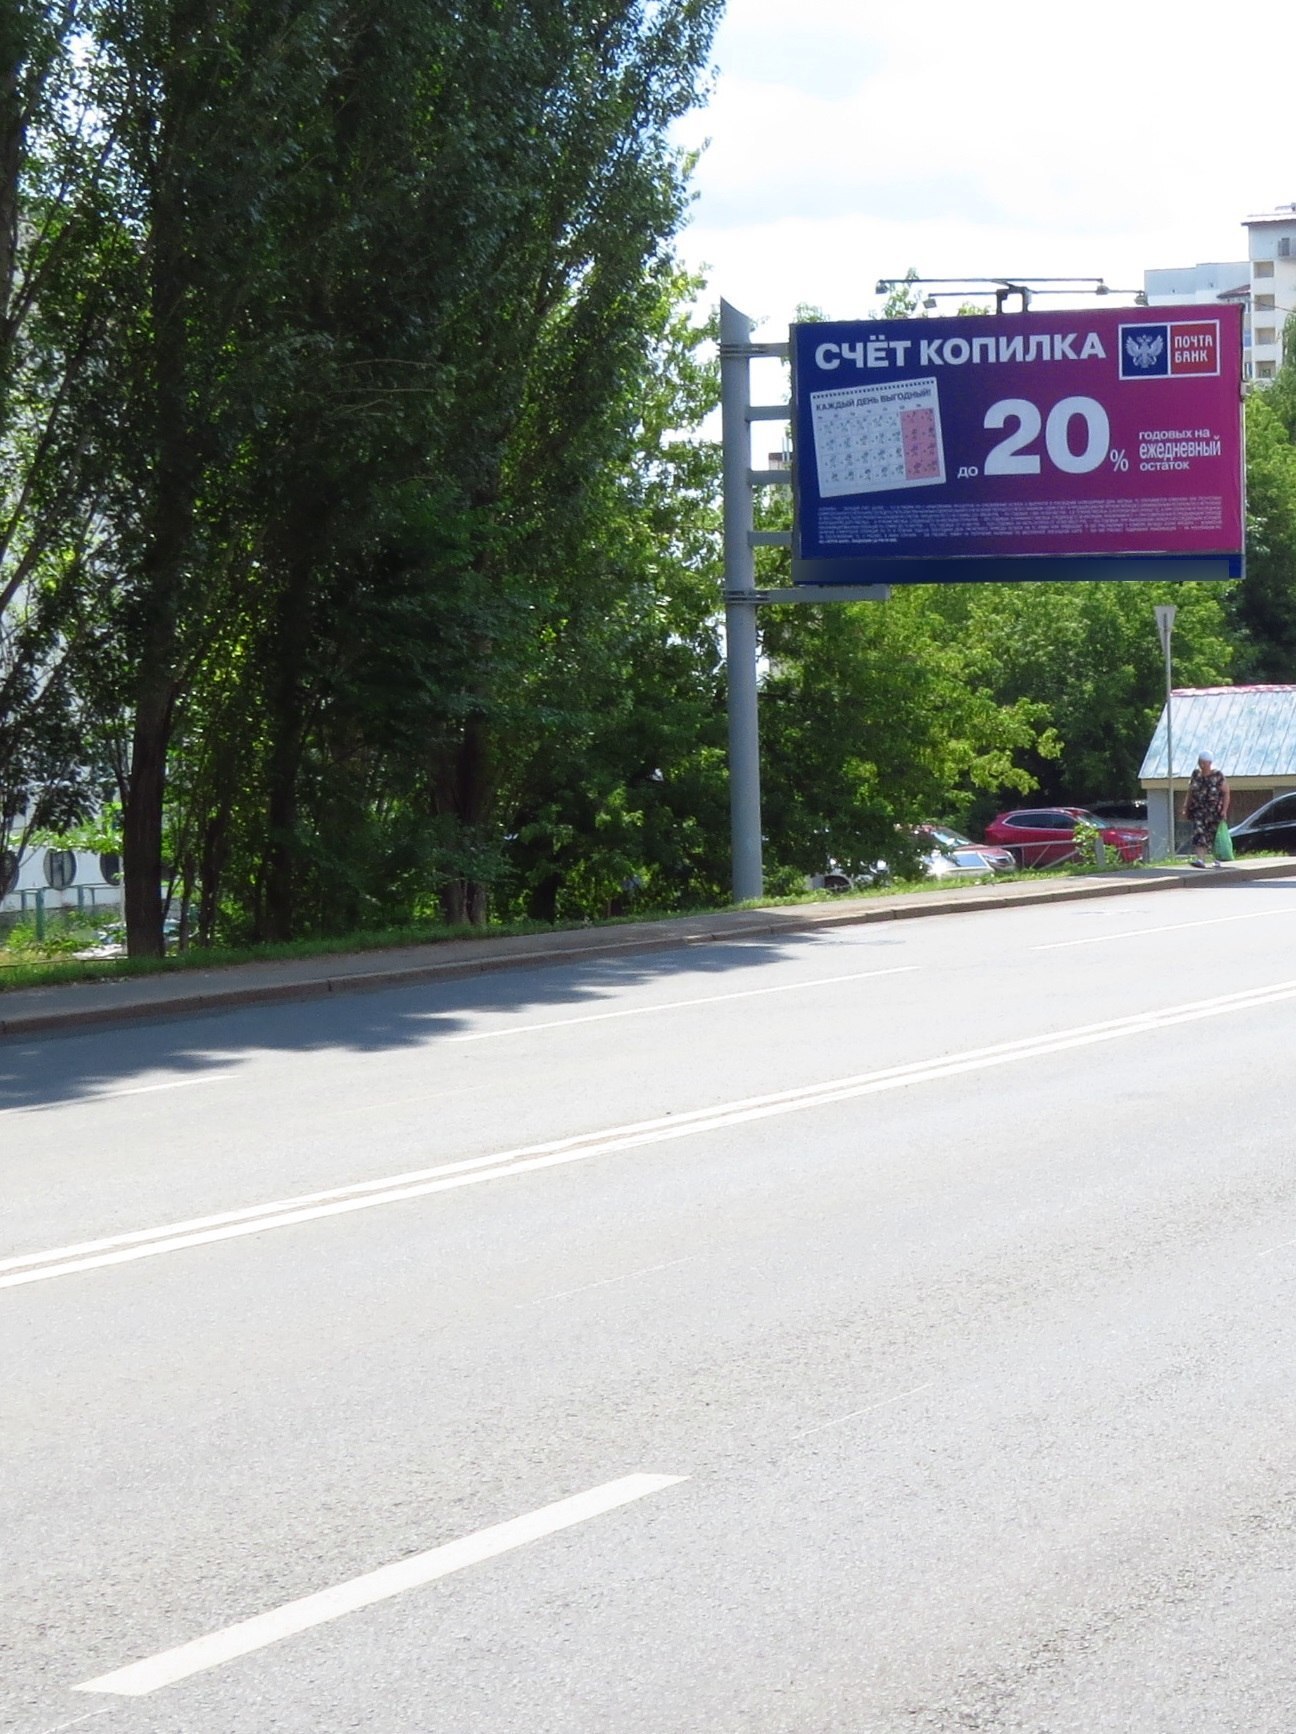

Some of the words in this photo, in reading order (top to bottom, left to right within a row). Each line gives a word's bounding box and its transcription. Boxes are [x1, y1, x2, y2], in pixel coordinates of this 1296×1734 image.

[1174, 335, 1213, 348] ПОЧТА
[815, 335, 911, 370] СЧЁТ
[919, 332, 1107, 366] КОПИЛКА
[1174, 350, 1209, 363] БАНК
[816, 398, 855, 412] КАЖДЫЙ
[856, 396, 880, 408] ДЕНЬ
[1139, 429, 1192, 441] годовых
[1194, 428, 1211, 438] на
[1139, 435, 1222, 461] ежедневный
[957, 466, 979, 479] до
[1139, 460, 1190, 472] остаток
